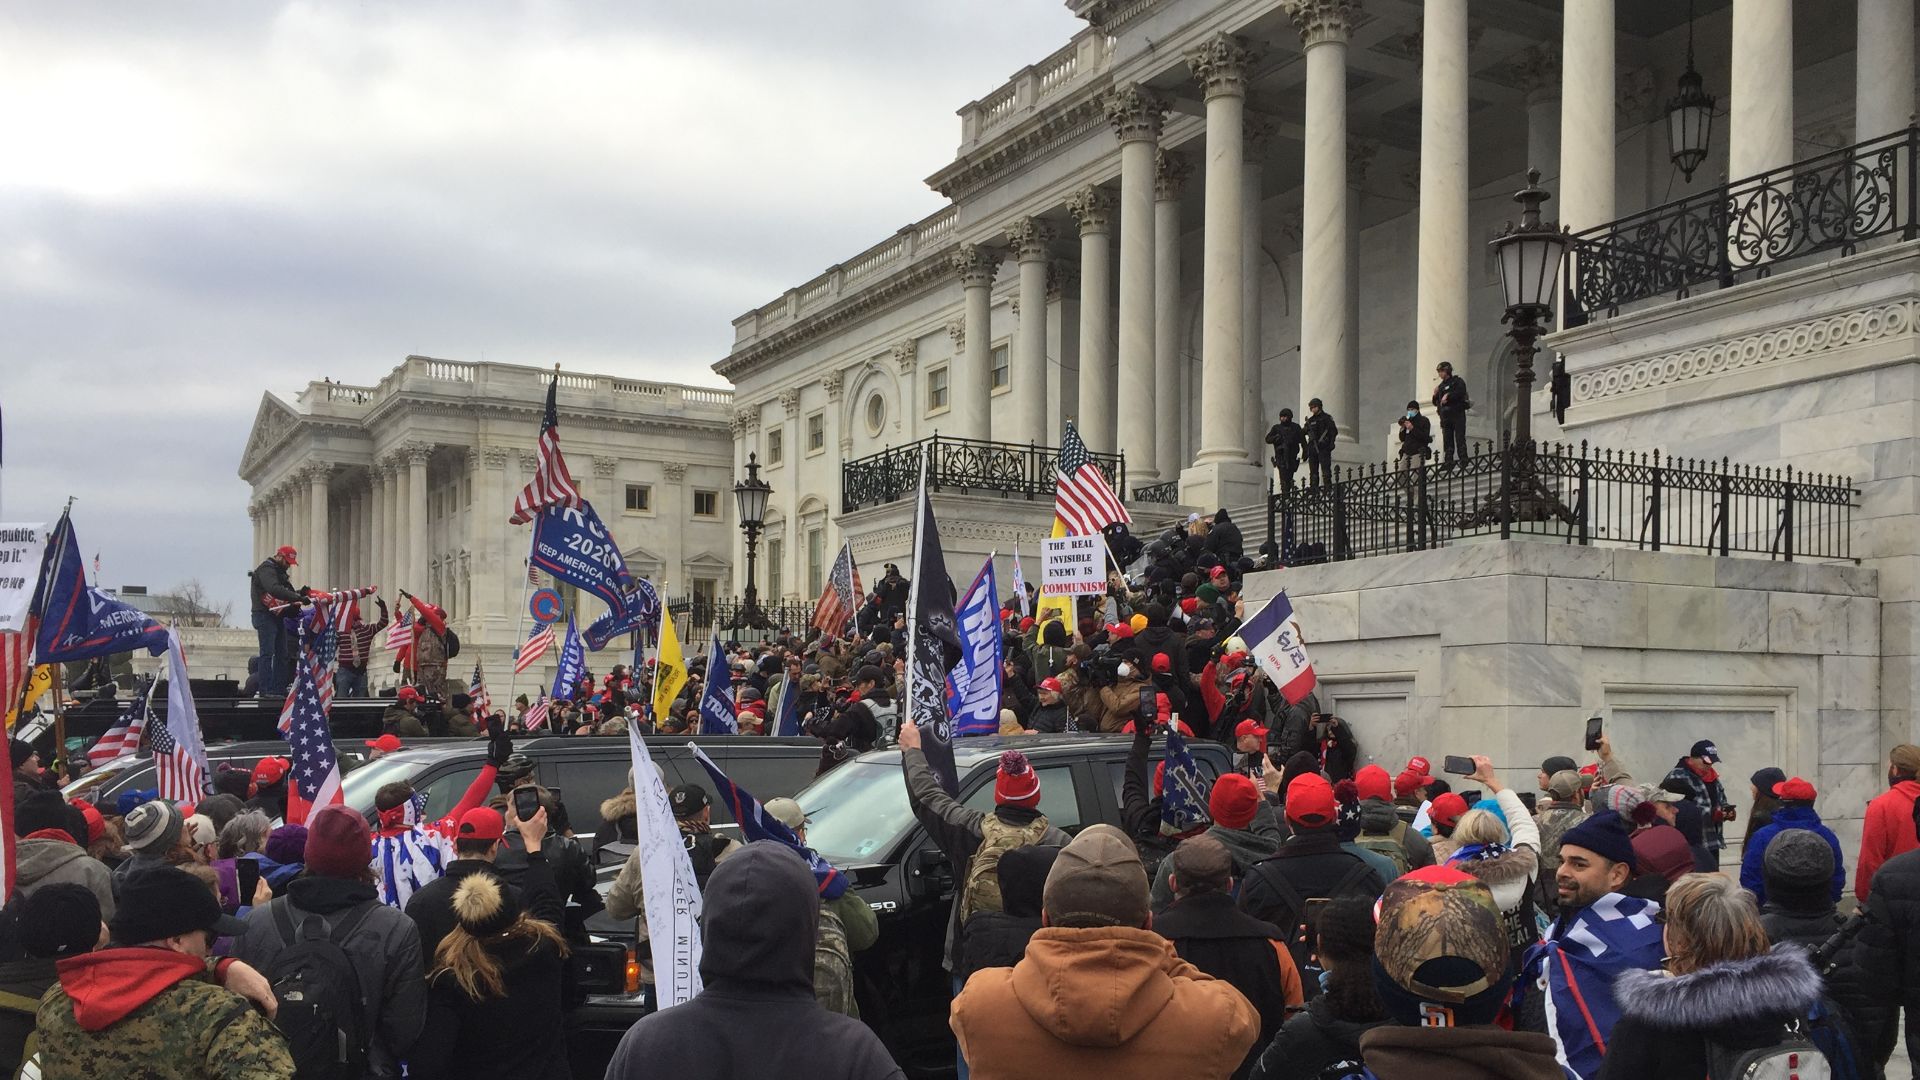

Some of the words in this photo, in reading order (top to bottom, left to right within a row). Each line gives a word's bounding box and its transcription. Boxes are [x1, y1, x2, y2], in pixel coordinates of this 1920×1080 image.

[1048, 542, 1065, 551] THE
[1071, 539, 1094, 549] REAL
[538, 542, 558, 559] KEEP
[557, 552, 604, 581] AMERICA
[1050, 553, 1092, 565] INVISIBLE
[1049, 567, 1077, 577] ENEMY
[1084, 566, 1093, 575] IS
[1043, 581, 1107, 595] COMMUNISM
[961, 573, 999, 720] TRUMP
[705, 694, 739, 736] TRUM
